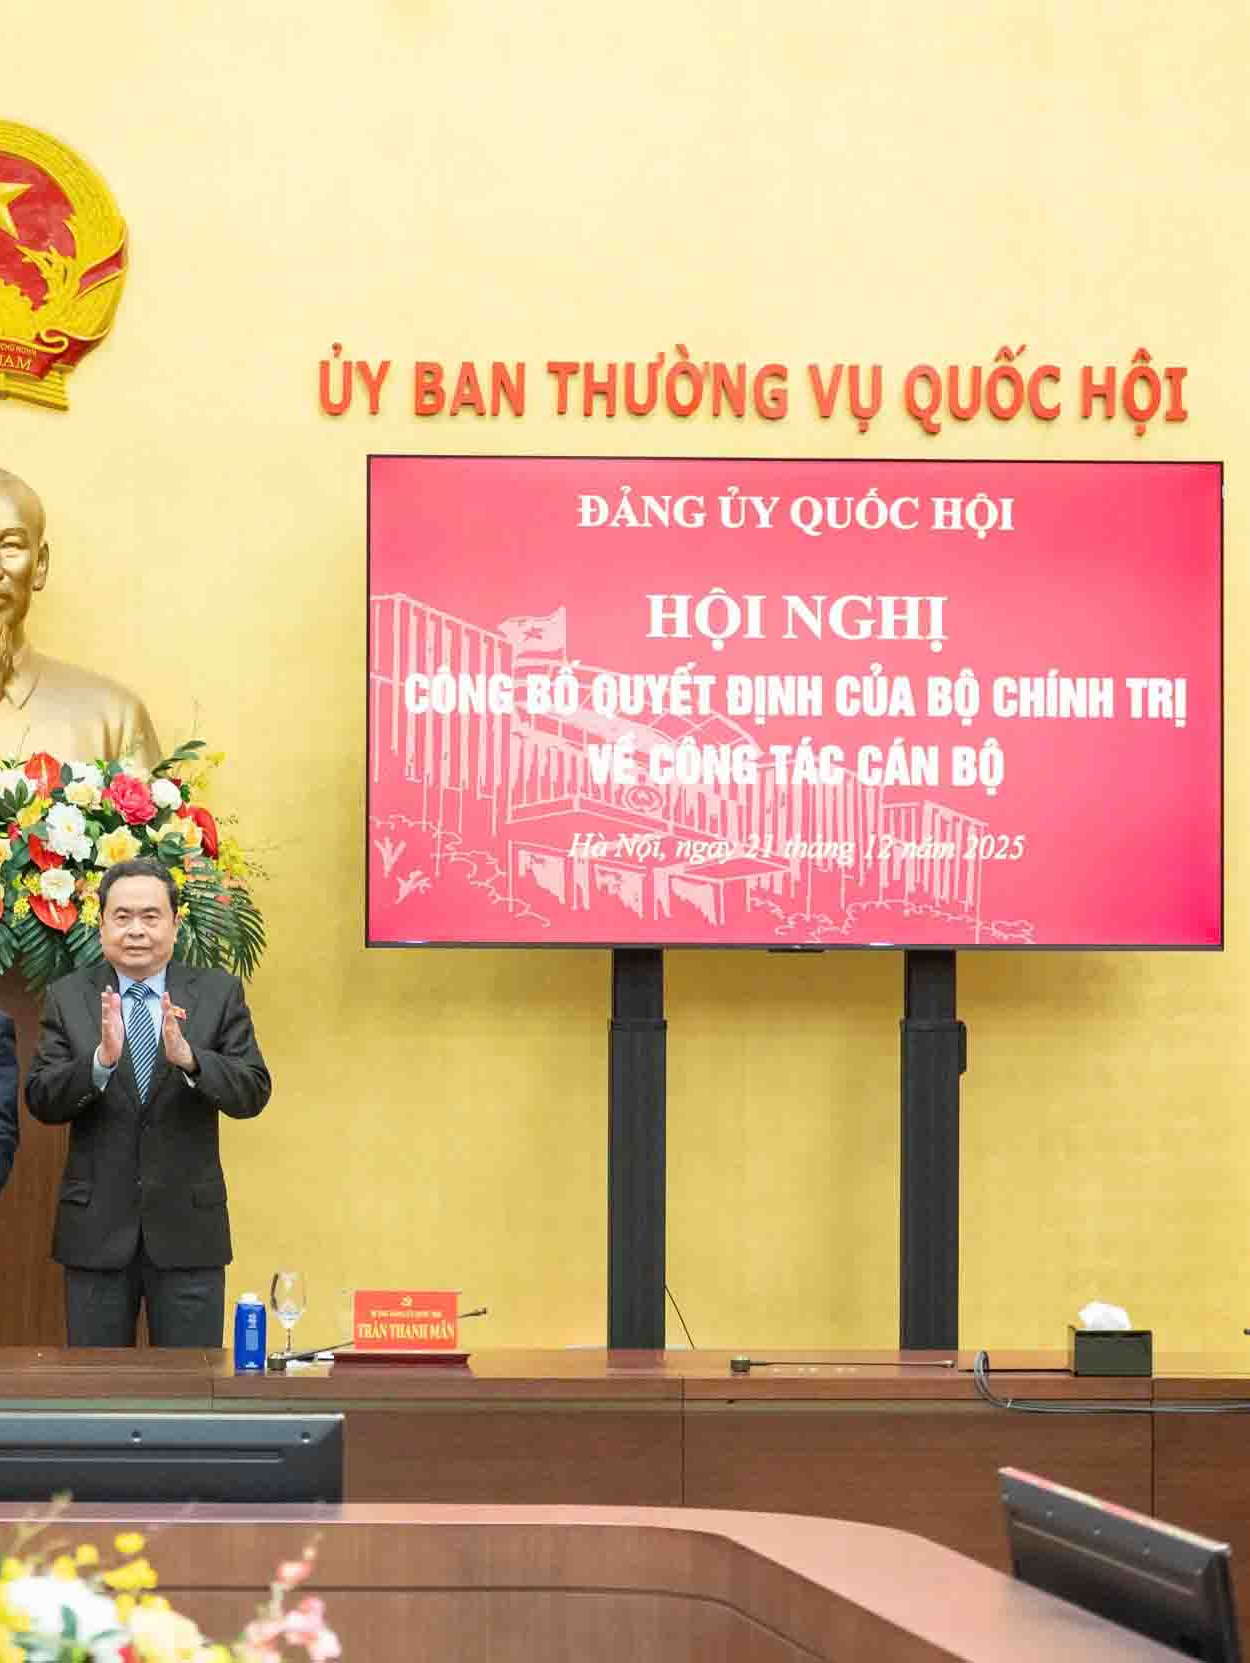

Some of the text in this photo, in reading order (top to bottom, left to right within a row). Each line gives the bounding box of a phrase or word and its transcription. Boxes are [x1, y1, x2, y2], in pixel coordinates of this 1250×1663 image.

[318, 342, 1189, 436] ỦY BAN THƯỜNG VỤ QUỐC HỘI
[576, 486, 1015, 539] ĐẢNG ỦY QUỐC HỘI
[645, 587, 949, 653] HỘI NGHỊ
[404, 660, 1188, 728] CÔNG BỐ QUYẾT ĐỊNH CỦA BỘ CHÍNH TRỊ
[588, 730, 1005, 796] VỀ CÔNG TÁC CÁN BỘ
[568, 832, 1026, 865] Hà Nội, ngày 21 tháng 12 năm 2025
[389, 1322, 429, 1339] THANH
